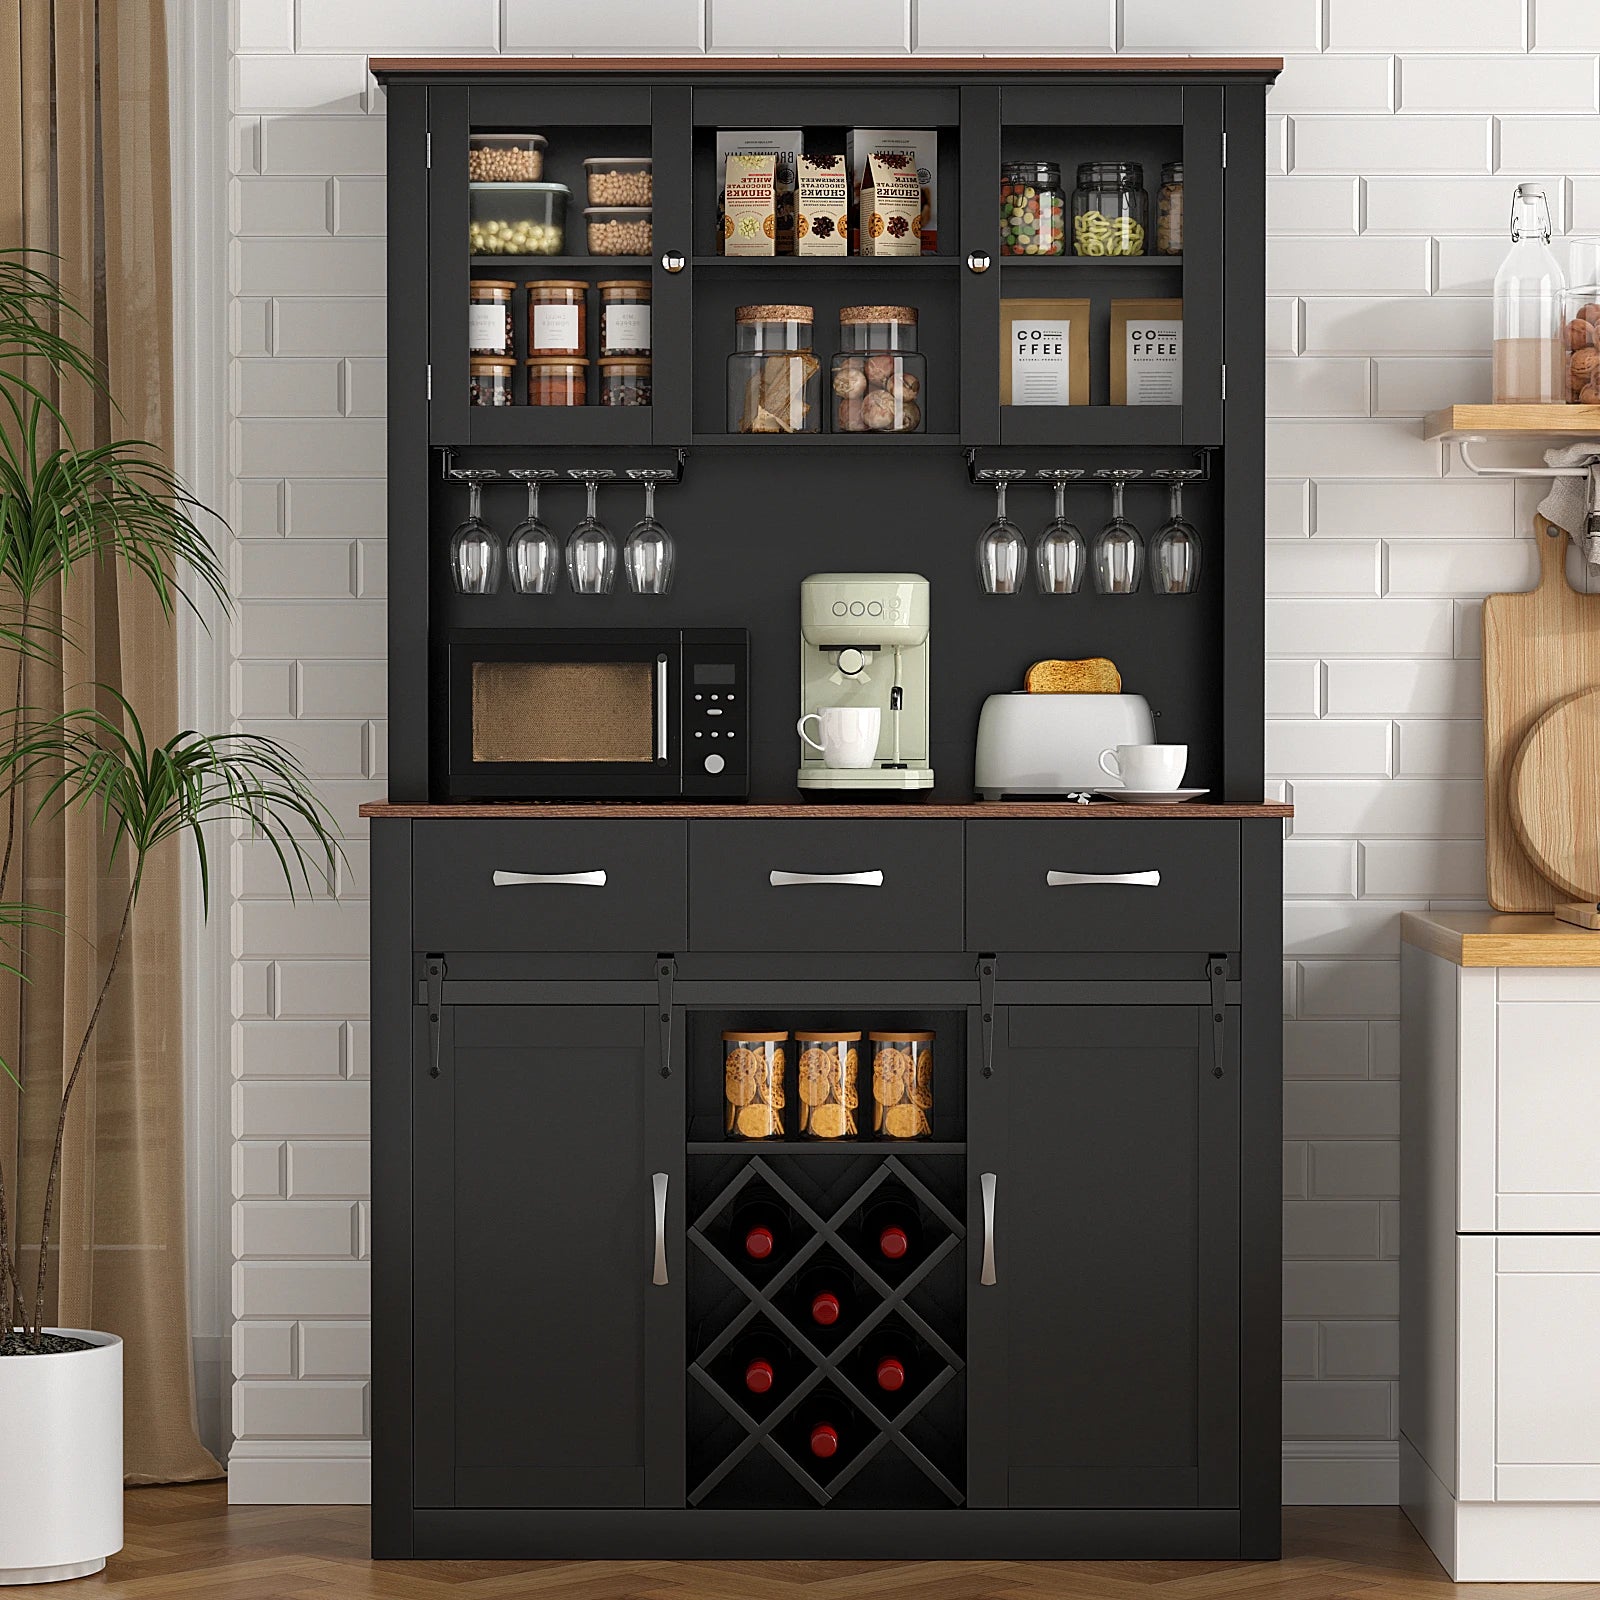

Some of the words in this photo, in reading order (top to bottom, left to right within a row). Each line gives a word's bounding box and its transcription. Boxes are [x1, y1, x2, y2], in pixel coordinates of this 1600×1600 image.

[1017, 330, 1042, 340] CO
[1131, 330, 1157, 340] CO
[1019, 344, 1062, 355] FFEE
[1133, 344, 1177, 355] FFEE
